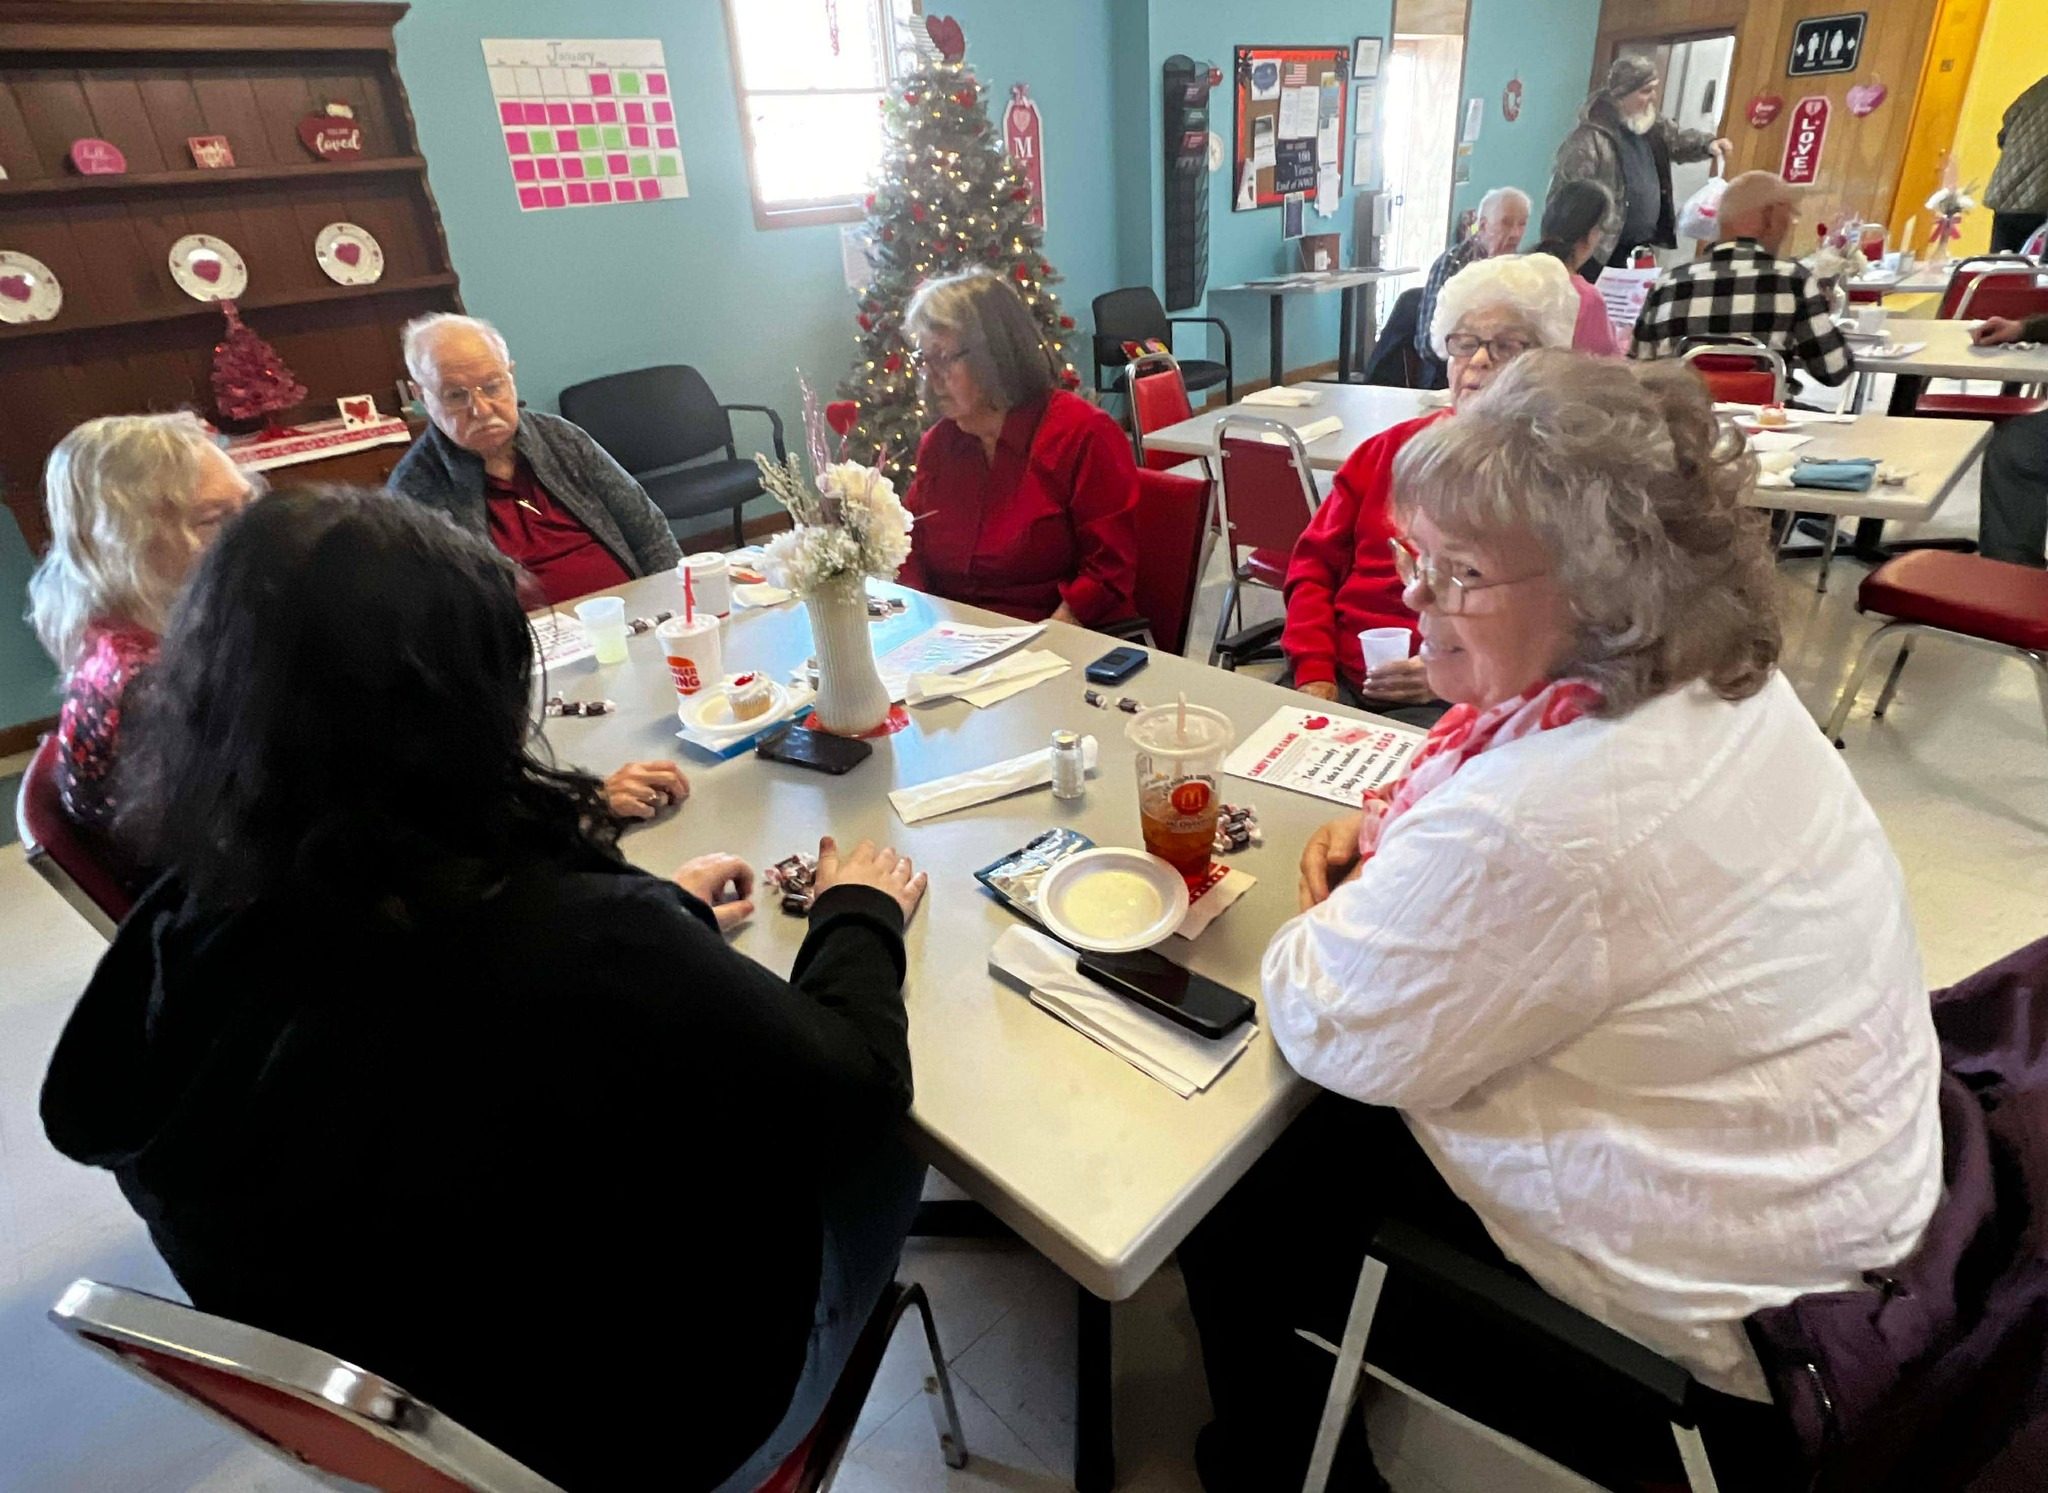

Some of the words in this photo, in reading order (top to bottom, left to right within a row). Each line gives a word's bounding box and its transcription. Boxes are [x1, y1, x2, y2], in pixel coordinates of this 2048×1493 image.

[547, 42, 594, 67] January
[316, 129, 361, 153] loved
[1793, 118, 1816, 169] LOVE
[674, 675, 700, 688] ING
[1372, 732, 1396, 752] XOXO
[1247, 758, 1272, 776] CANDY
[1301, 766, 1320, 780] Take
[1321, 771, 1340, 784] Take
